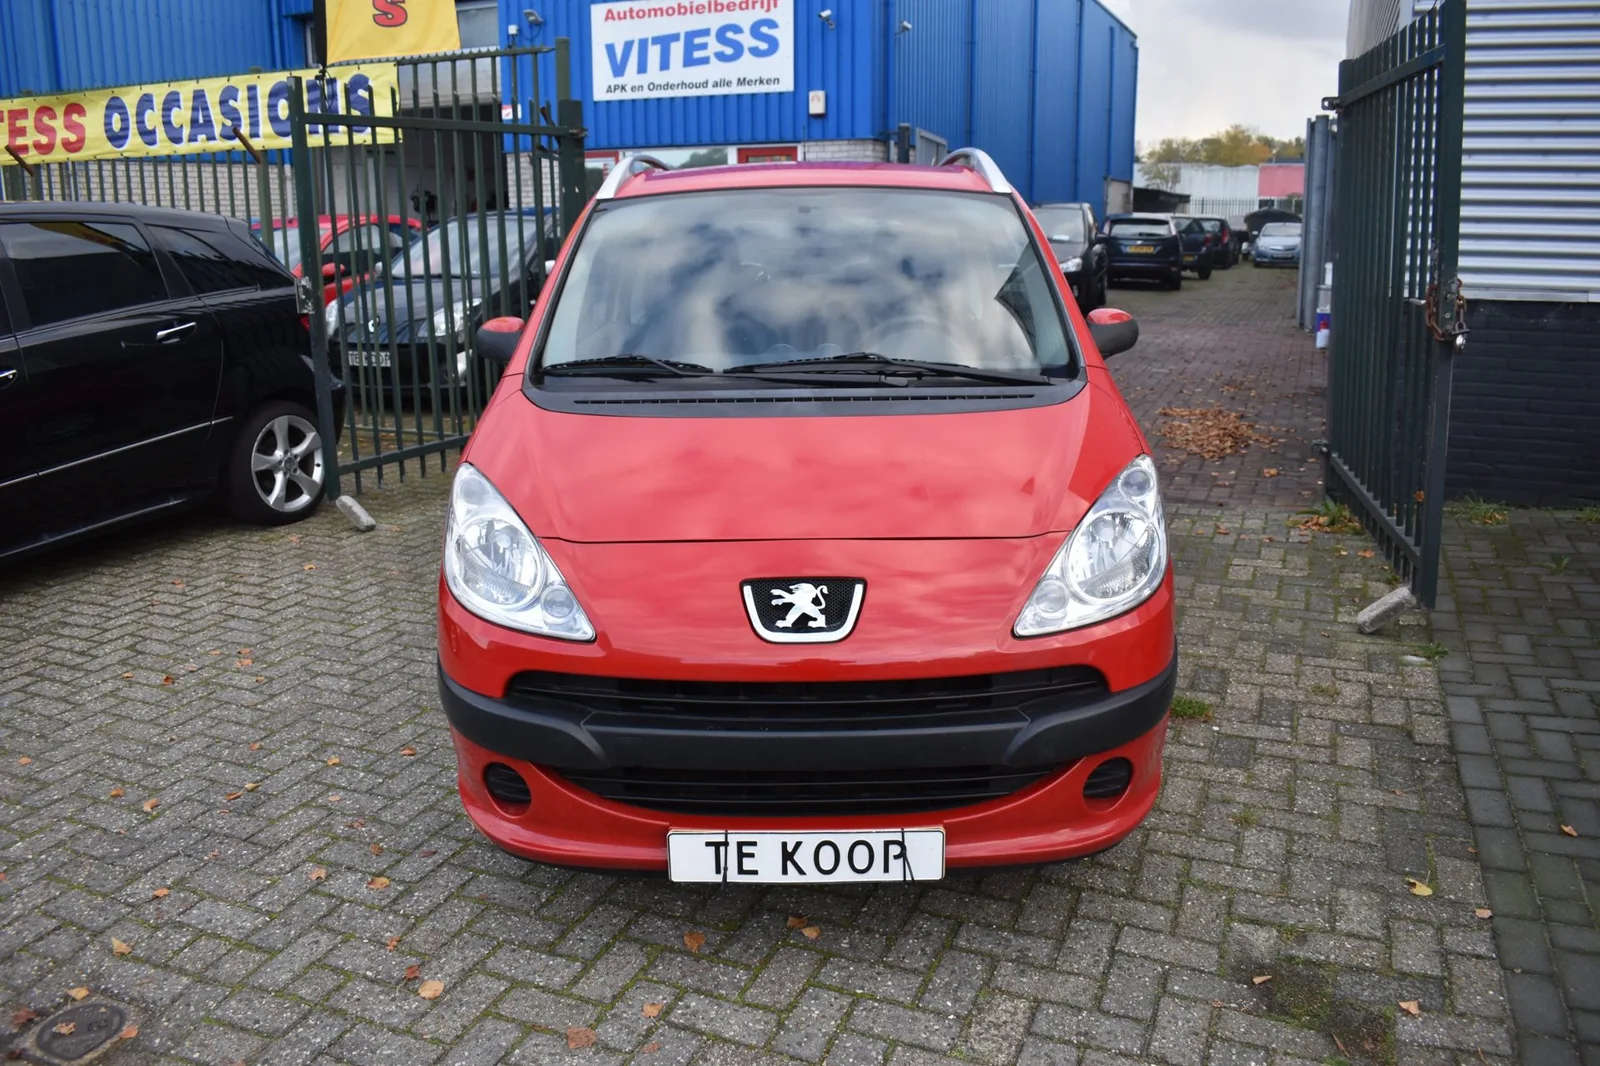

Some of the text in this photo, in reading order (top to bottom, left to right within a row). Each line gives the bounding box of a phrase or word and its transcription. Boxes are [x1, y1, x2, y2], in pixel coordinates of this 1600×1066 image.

[604, 18, 780, 78] VITESS
[605, 75, 780, 94] APK en Onderhoud alle Merken
[0, 73, 372, 156] ESS OCCASIONS
[705, 839, 907, 876] TE KOOP
